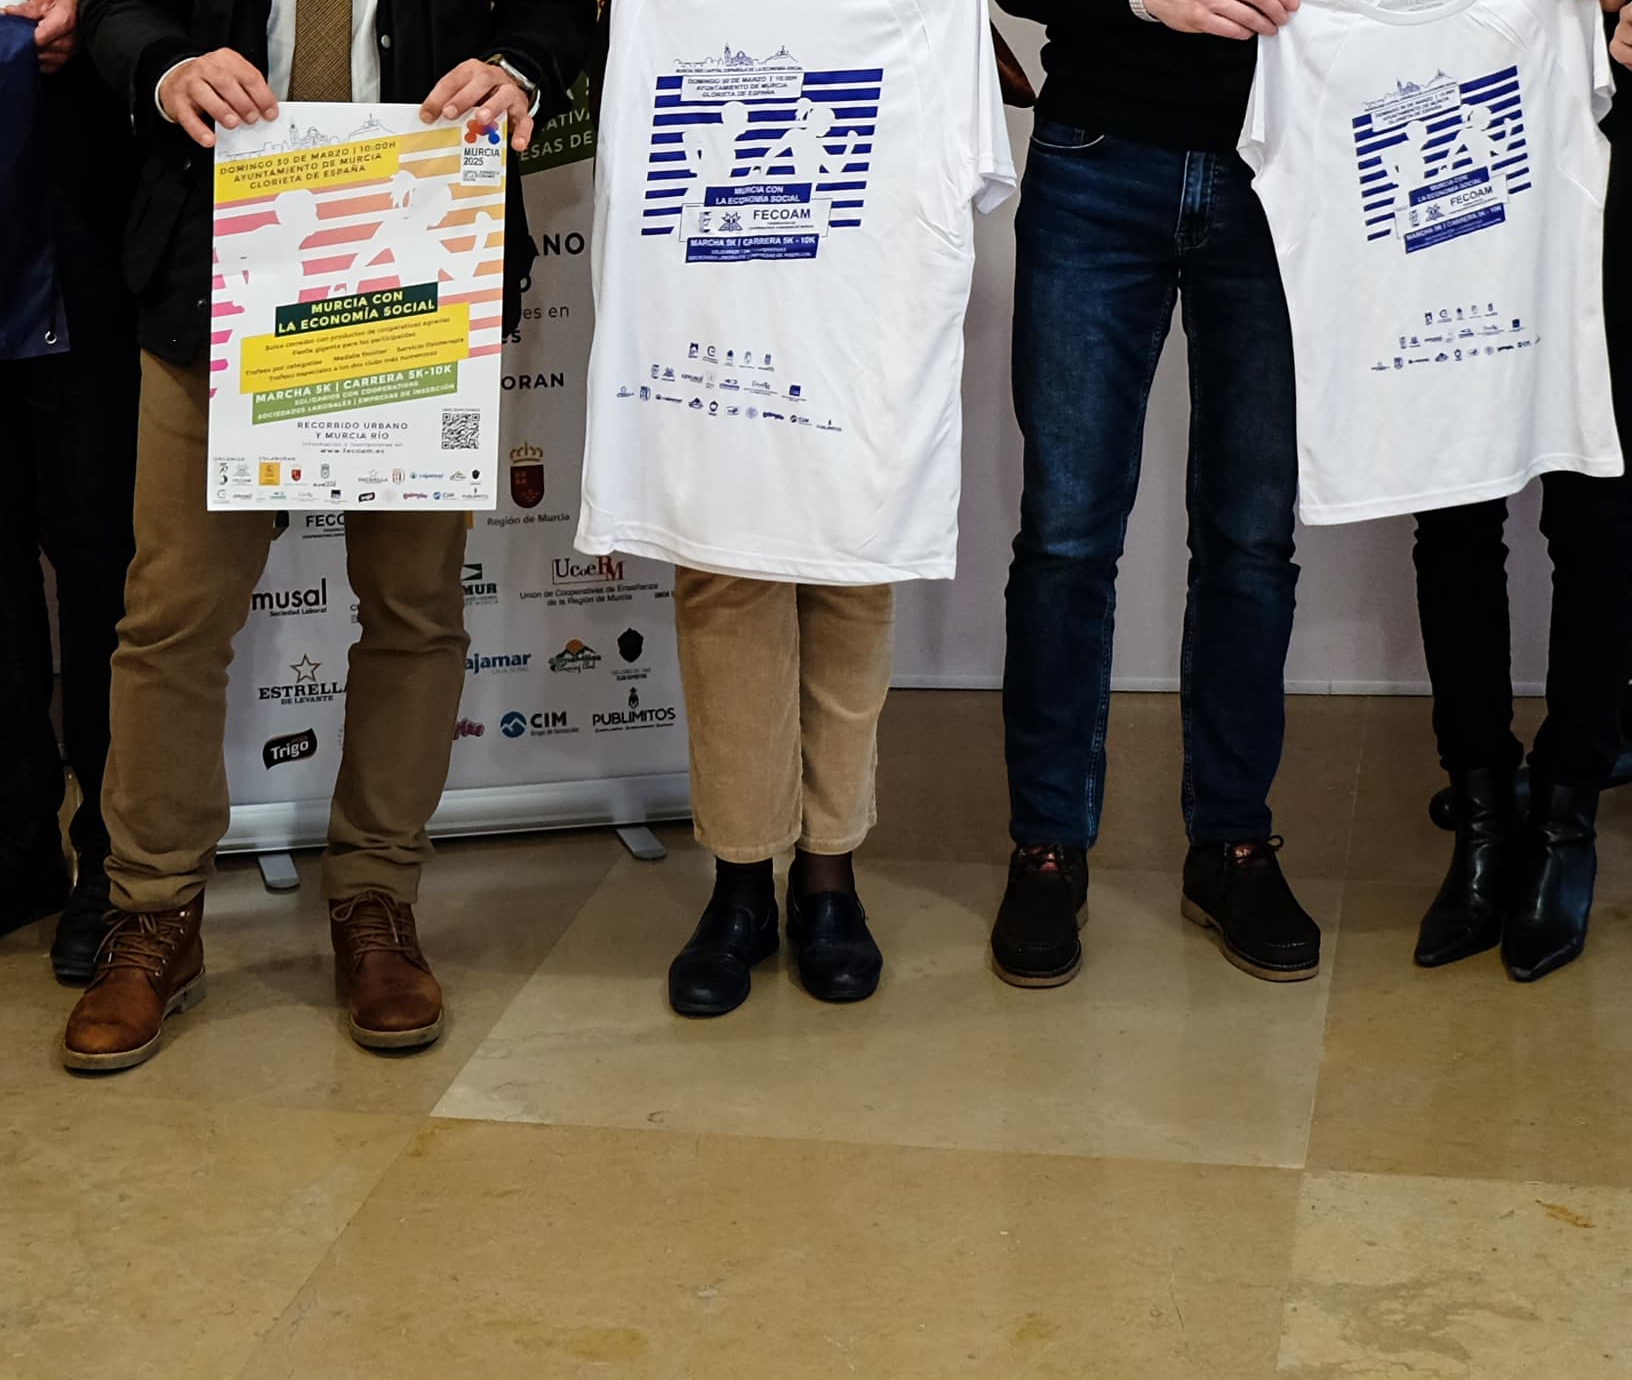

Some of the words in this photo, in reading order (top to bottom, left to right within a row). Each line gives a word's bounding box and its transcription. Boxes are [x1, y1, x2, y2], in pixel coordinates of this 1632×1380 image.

[521, 138, 563, 161] ESAS
[570, 130, 593, 148] DE
[1450, 186, 1493, 206] FECOAM
[753, 208, 811, 220] FECOAM
[310, 296, 368, 315] MURCIA
[372, 290, 403, 304] CON
[278, 320, 296, 333] LA
[300, 305, 379, 330] ECONOMÍA
[382, 299, 435, 316] SOCIAL
[501, 372, 564, 390] ORAN
[306, 513, 344, 527] FECO
[487, 515, 521, 527] Región
[523, 514, 536, 523] de
[537, 513, 570, 522] Murcia
[252, 578, 326, 610] musal
[462, 583, 497, 595] MUR
[465, 653, 531, 673] ajamar
[259, 682, 344, 700] ESTRELL
[530, 711, 567, 728] CIM
[592, 707, 676, 726] PUBLIMITOS
[270, 740, 309, 760] Trigo
